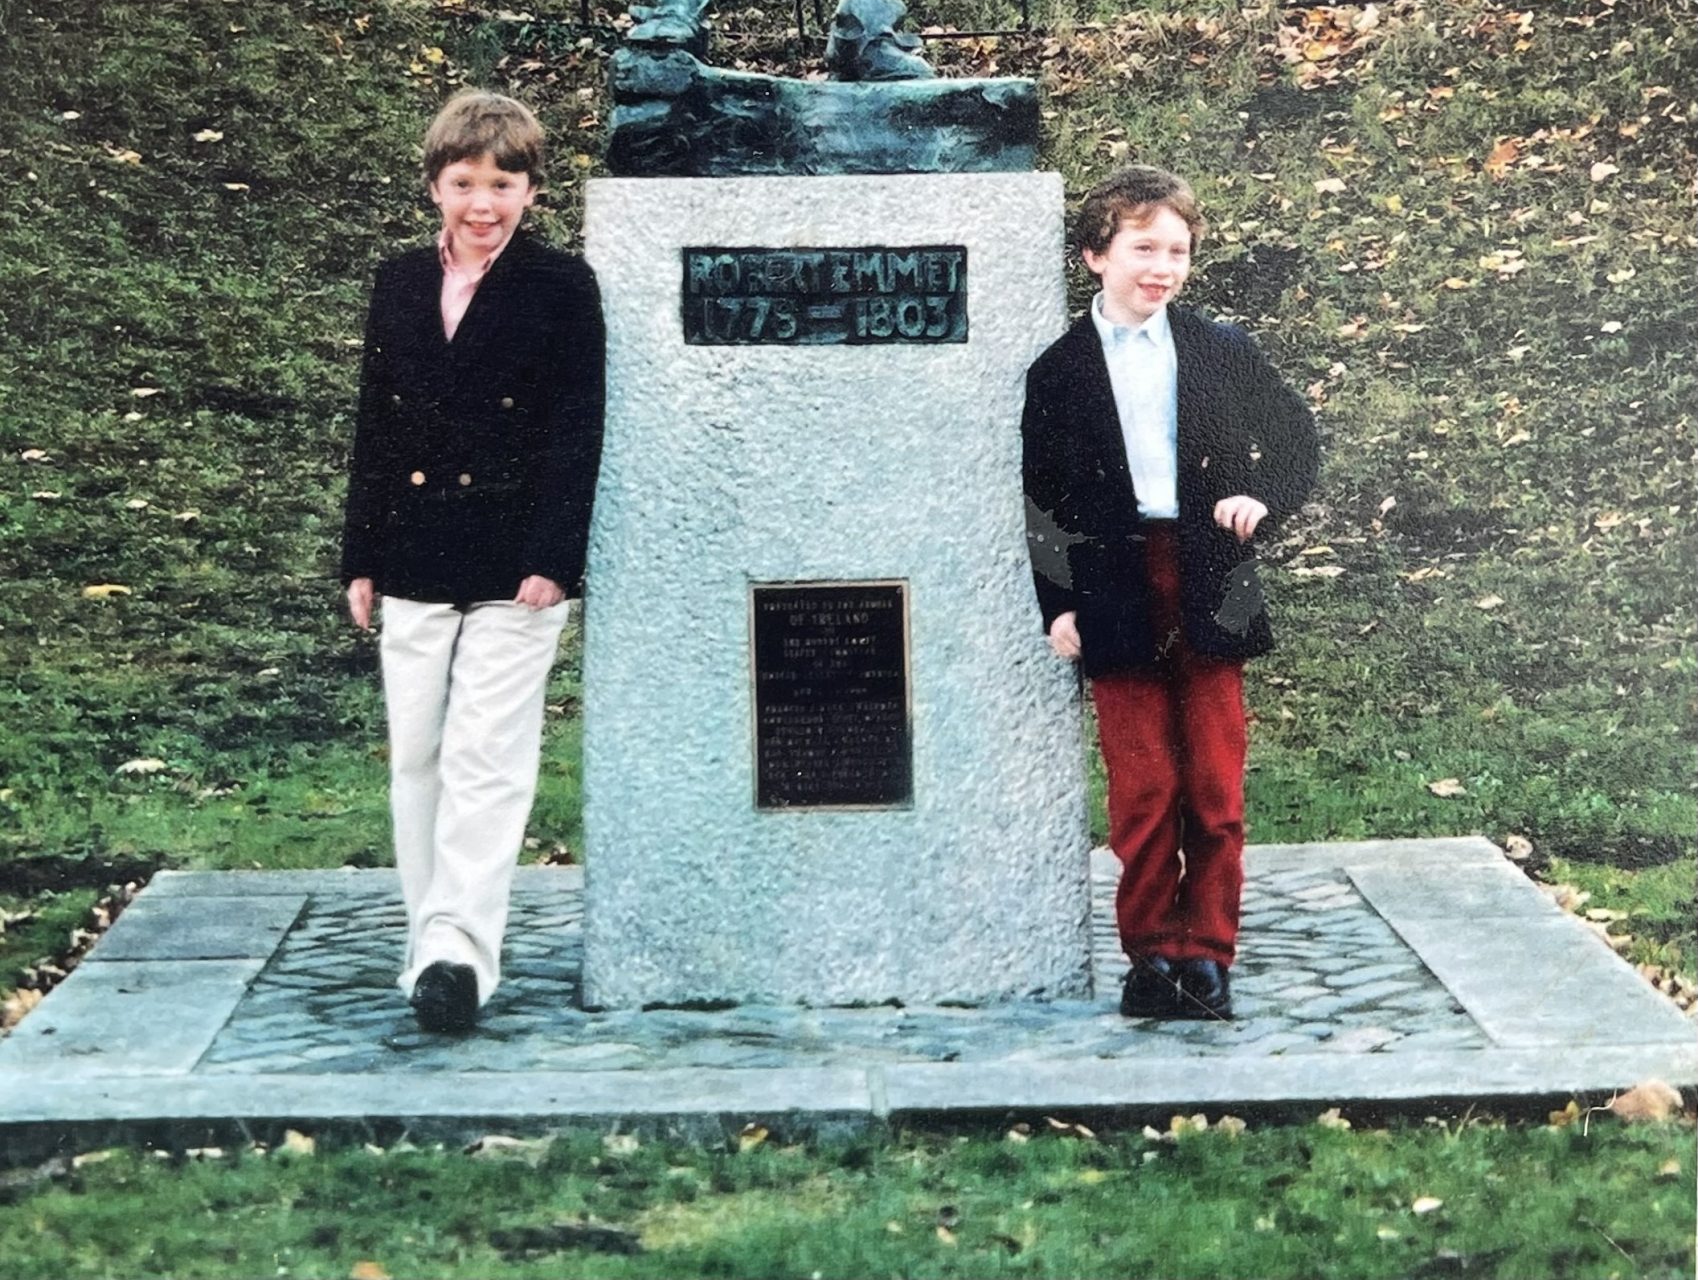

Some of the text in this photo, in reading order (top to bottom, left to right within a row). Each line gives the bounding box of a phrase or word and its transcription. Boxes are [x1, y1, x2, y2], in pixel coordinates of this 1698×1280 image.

[690, 251, 962, 294] ROBERT EMMET
[854, 295, 951, 339] 1803
